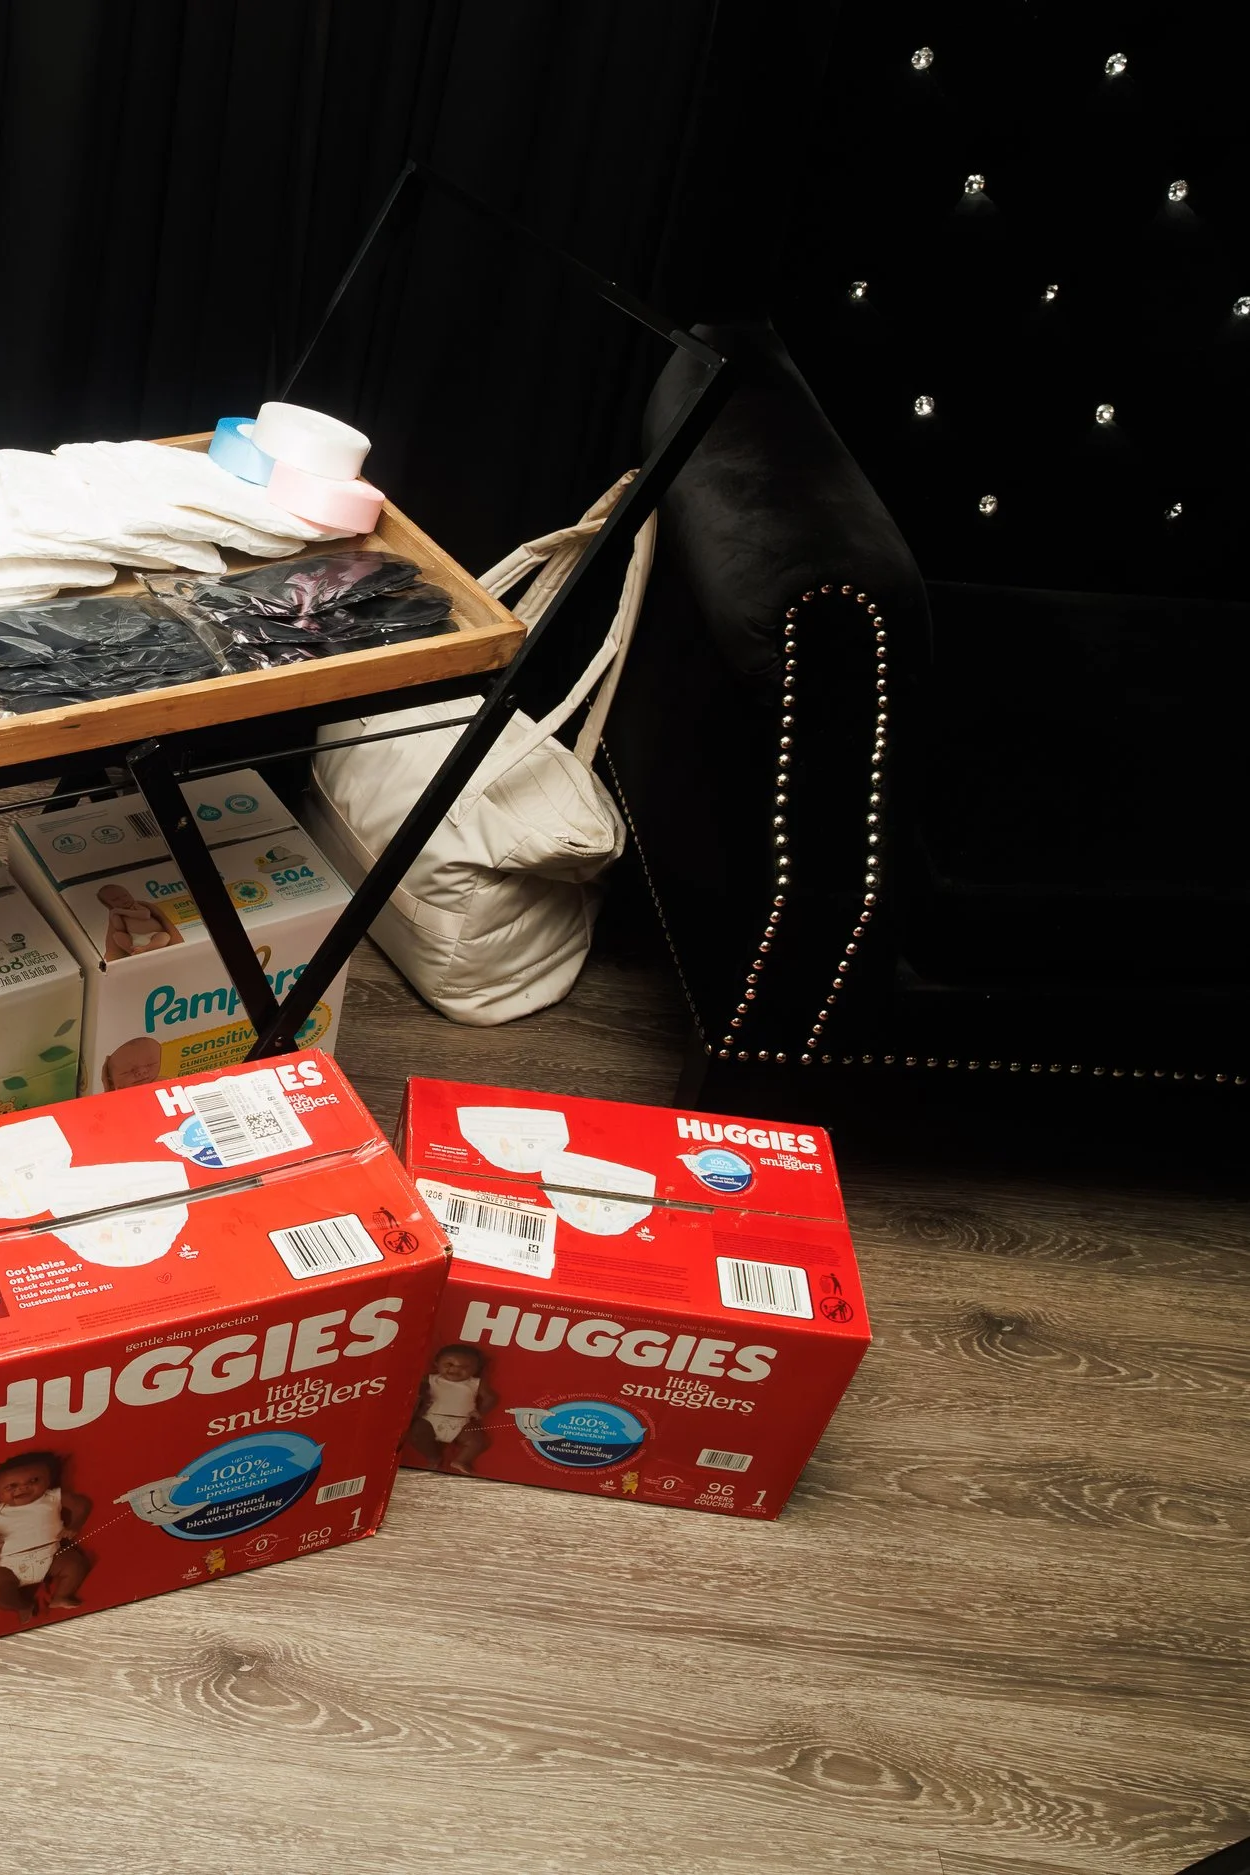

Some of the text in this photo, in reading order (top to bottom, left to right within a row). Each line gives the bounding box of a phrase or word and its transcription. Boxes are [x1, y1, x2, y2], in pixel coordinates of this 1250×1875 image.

[270, 866, 314, 885] 504
[24, 952, 59, 967] LINGETTES
[181, 1027, 258, 1058] sensitiv
[180, 1044, 254, 1069] CLINICALLY PROV
[290, 1093, 338, 1114] gglers
[676, 1117, 818, 1154] HUGGIES
[759, 1156, 823, 1172] snugglers
[777, 1152, 797, 1162] little
[425, 1189, 443, 1200] 1206
[475, 1193, 521, 1208] CONVEYABLE
[5, 1268, 27, 1278] Got
[27, 1260, 66, 1275] babies
[9, 1263, 84, 1286] on the move?
[12, 1277, 70, 1294] Check out our
[15, 1292, 39, 1302] Little
[77, 1280, 90, 1289] for
[18, 1282, 115, 1310] Outstanding Active Fit!
[532, 1302, 555, 1311] gentle
[556, 1305, 572, 1313] skin
[573, 1308, 613, 1319] protection
[125, 1313, 260, 1353] gentle skin protection
[458, 1301, 778, 1382] HUGGIES
[265, 1377, 323, 1404] little
[665, 1376, 710, 1395] little
[206, 1376, 388, 1437] snugglers
[619, 1380, 756, 1415] snugglers
[569, 1416, 610, 1431] 100%
[562, 1430, 605, 1440] protection
[546, 1444, 613, 1460] blowout blocking
[560, 1442, 602, 1453] all-around
[211, 1457, 270, 1483] 100%
[231, 1456, 242, 1466] up
[195, 1466, 284, 1493] blowout & leak
[206, 1477, 268, 1500] protection
[707, 1482, 735, 1496] 96
[206, 1494, 265, 1516] all-around
[694, 1498, 734, 1509] COUCHES
[699, 1492, 734, 1503] DIAPERS
[751, 1490, 767, 1507] 1
[186, 1498, 283, 1529] blowout blocking
[348, 1507, 361, 1530] 1
[299, 1526, 332, 1544] 160
[298, 1538, 330, 1552] DIAPERS
